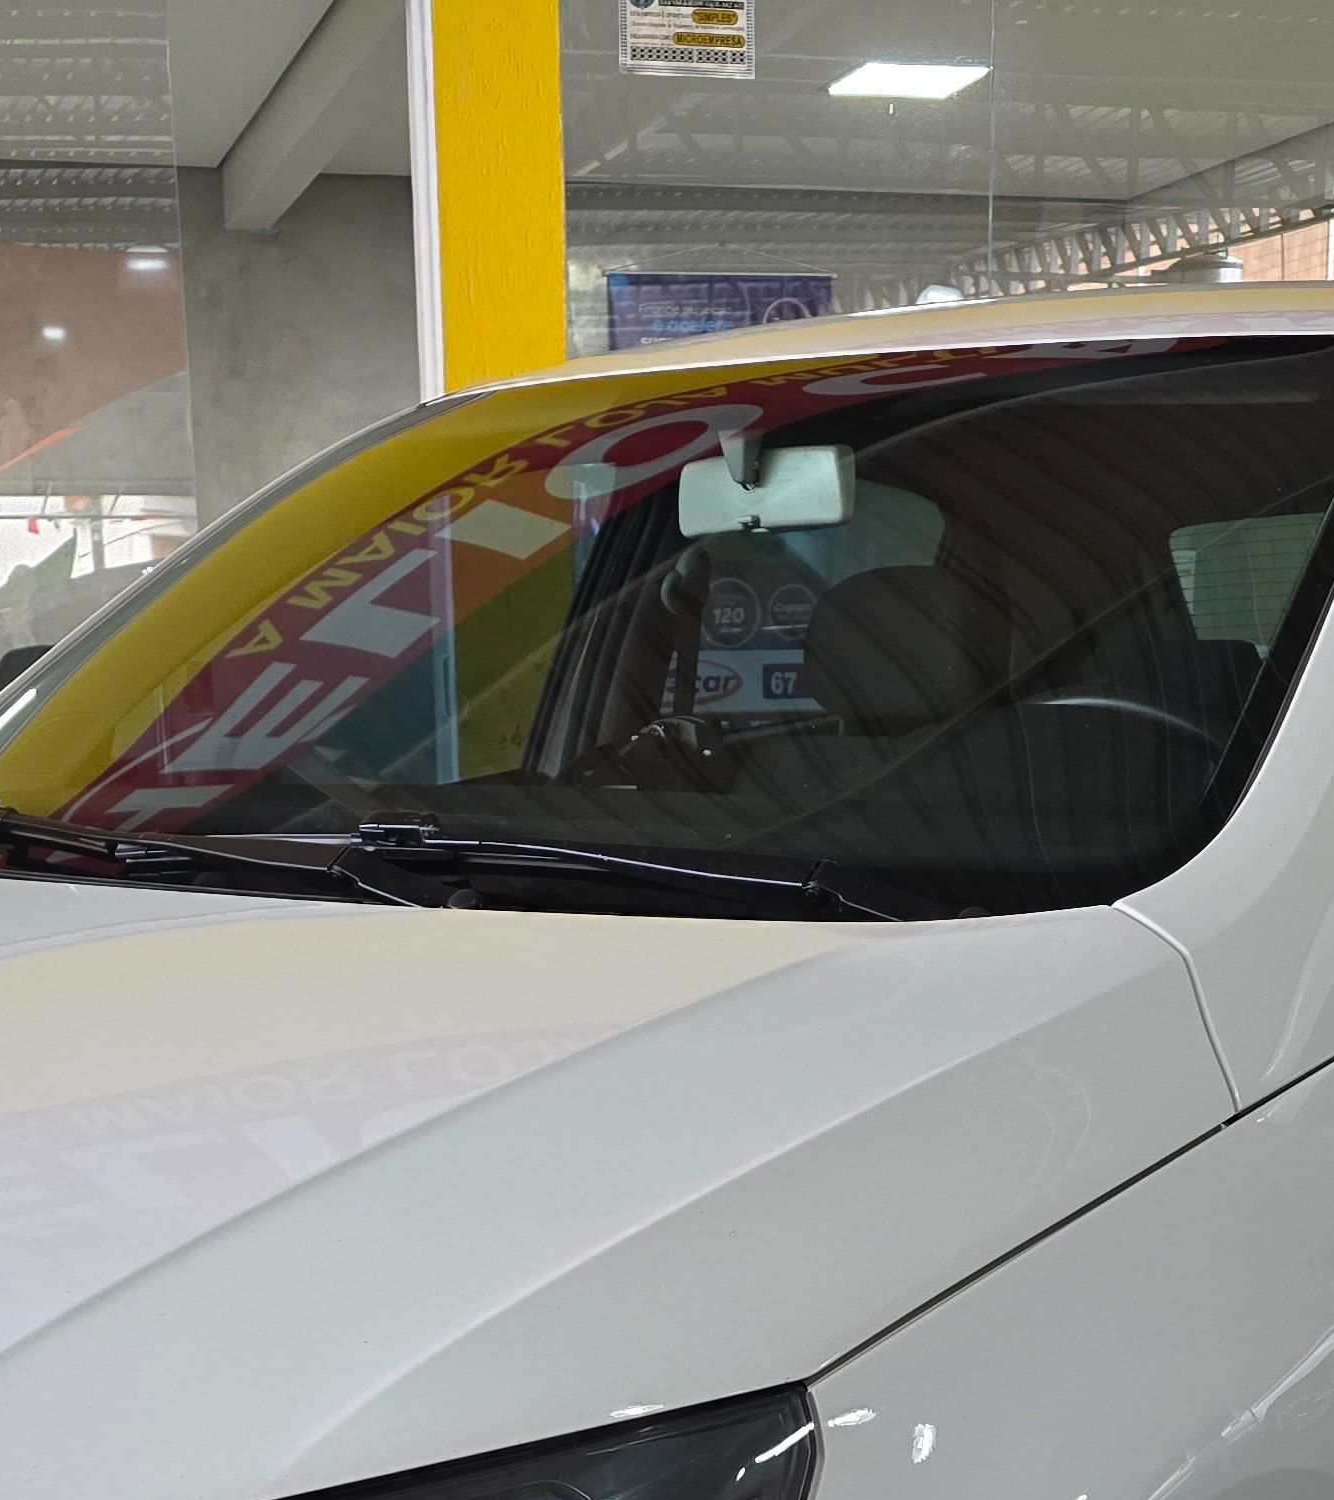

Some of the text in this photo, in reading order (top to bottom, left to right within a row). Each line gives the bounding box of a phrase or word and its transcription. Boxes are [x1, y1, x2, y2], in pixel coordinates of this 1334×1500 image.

[676, 34, 742, 46] MICROEMPRESA
[713, 607, 745, 624] 120
[770, 671, 797, 695] 67
